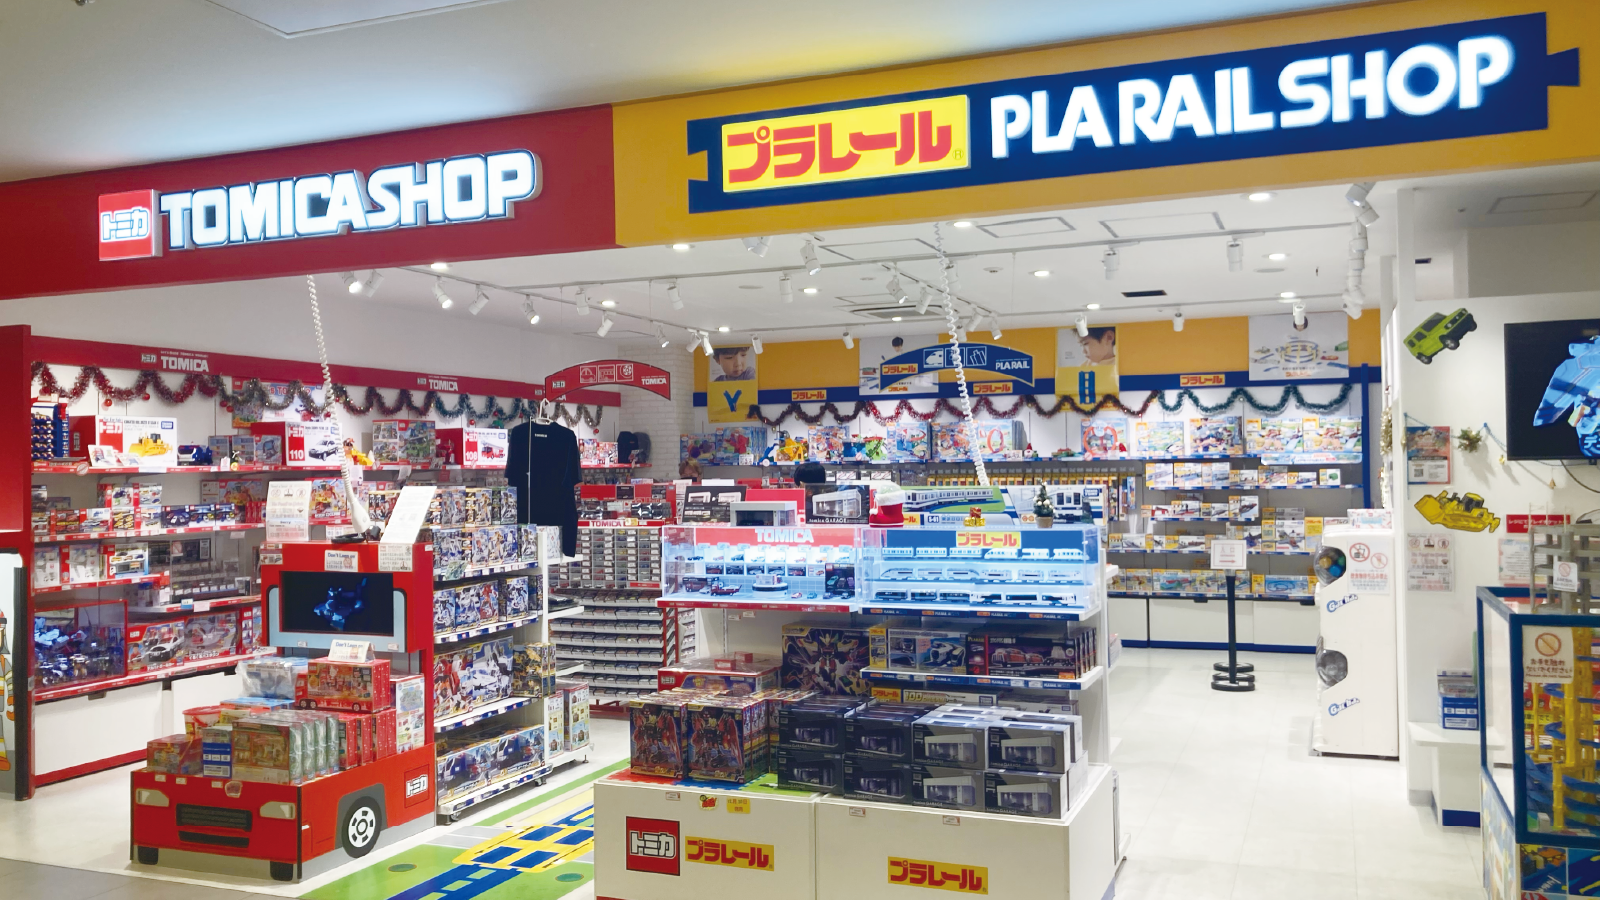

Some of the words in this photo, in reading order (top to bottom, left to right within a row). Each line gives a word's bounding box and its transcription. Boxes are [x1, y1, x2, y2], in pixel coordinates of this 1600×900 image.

[727, 109, 952, 184] プラレール
[101, 206, 149, 242] トミカ
[141, 354, 157, 363] トミカ
[161, 356, 209, 372] TOMICA
[883, 365, 916, 374] プラレール
[428, 379, 458, 391] TOMICA
[641, 378, 667, 386] TOMICA
[1181, 376, 1223, 385] プラレール
[974, 384, 1011, 394] プラレール
[793, 391, 825, 400] プラレール
[99, 422, 123, 434] トミカ
[1584, 435, 1600, 449] デ
[289, 450, 304, 460] 110
[465, 451, 477, 460] 108
[755, 528, 814, 543] TOMICA
[957, 533, 1017, 547] プラレール
[873, 689, 899, 698] プラレール
[405, 774, 428, 798] トミカ
[630, 831, 676, 859] トミカ
[687, 839, 769, 869] プラレール
[890, 860, 983, 891] プラレール
